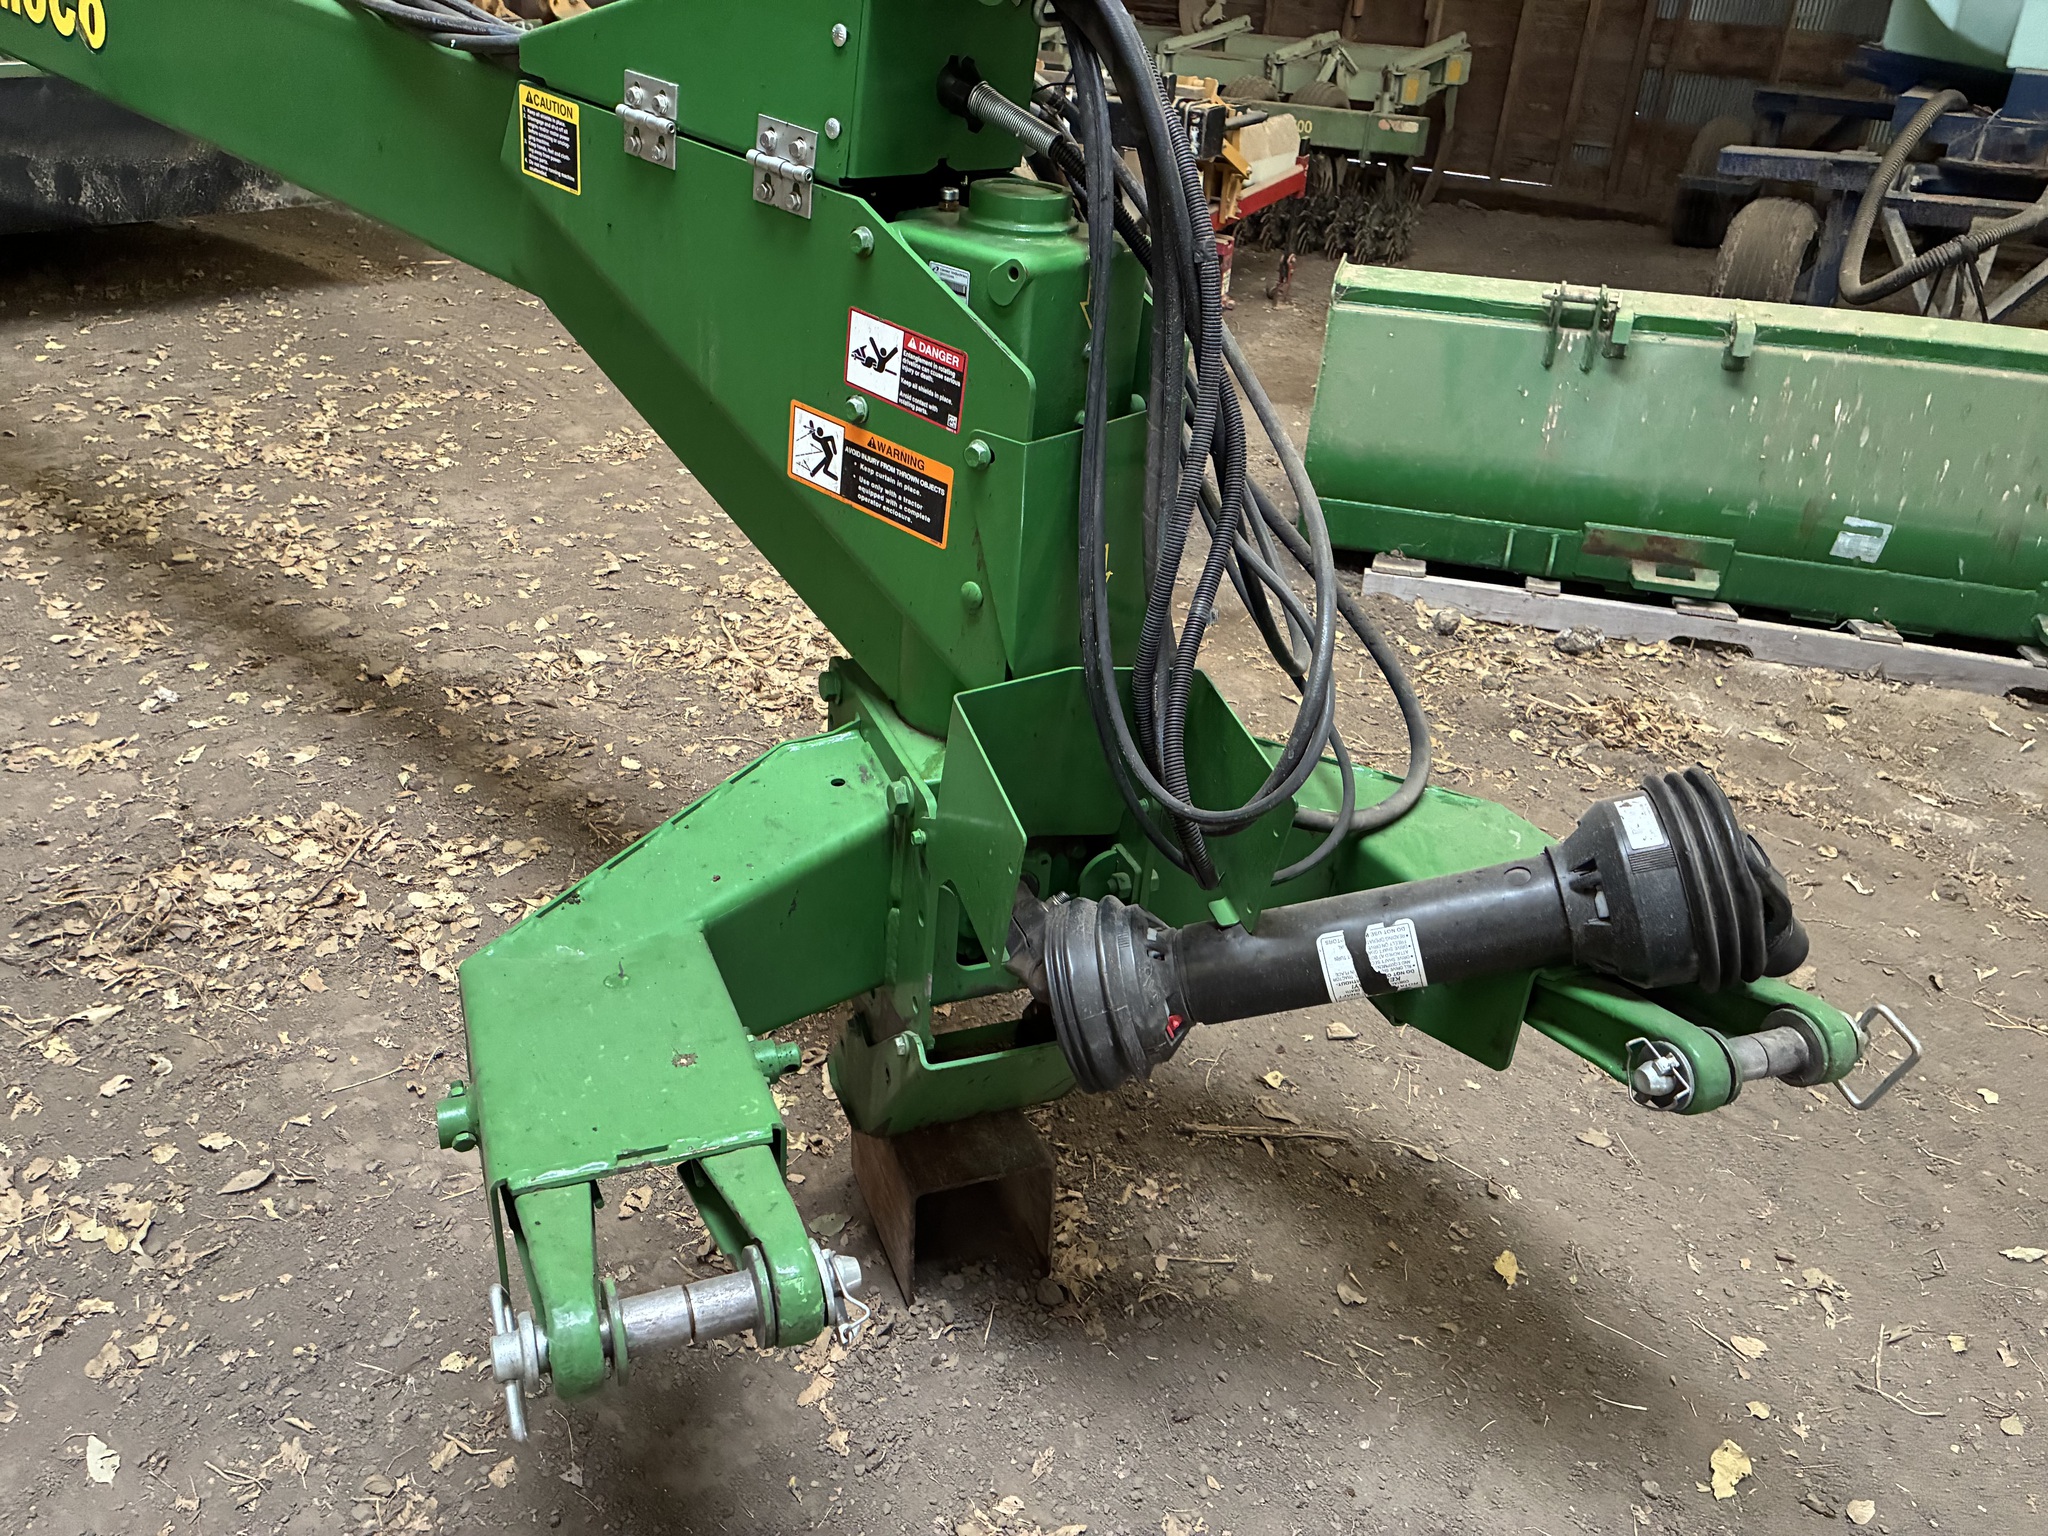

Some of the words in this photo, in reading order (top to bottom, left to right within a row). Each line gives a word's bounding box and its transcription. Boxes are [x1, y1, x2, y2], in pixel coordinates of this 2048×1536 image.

[534, 93, 573, 119] CAUTION
[1298, 120, 1313, 133] 00
[903, 350, 933, 368] Entanglement
[938, 365, 956, 379] rotating
[919, 341, 960, 368] DANGER
[902, 357, 921, 370] driveline
[921, 365, 930, 374] can
[930, 369, 943, 380] cause
[944, 375, 961, 387] serious
[902, 364, 914, 375] injury
[920, 372, 934, 384] death.
[899, 390, 911, 401] Avoid
[912, 396, 928, 408] contact
[929, 403, 939, 413] with
[901, 377, 912, 388] Keep
[918, 385, 934, 397] shields
[934, 392, 939, 400] in
[939, 394, 953, 406] place.
[899, 398, 915, 411] rotating
[916, 405, 928, 416] parts.
[845, 445, 861, 459] AVOID
[861, 453, 879, 467] INJURY
[880, 461, 895, 474] FROM
[896, 469, 919, 485] THROWN
[920, 479, 945, 496] OBJECTS
[877, 441, 925, 471] WARNING
[859, 476, 870, 488] Use
[871, 481, 883, 494] only
[885, 487, 897, 500] with
[898, 493, 902, 501] a
[903, 495, 923, 511] tractor
[860, 464, 874, 477] Keep
[875, 470, 896, 486] curtain
[897, 479, 903, 489] in
[903, 482, 922, 497] place.
[857, 493, 881, 510] operator
[882, 504, 913, 524] enclosure.
[858, 485, 884, 504] equipped
[885, 496, 898, 509] with
[899, 502, 902, 511] a
[904, 504, 931, 524] complete
